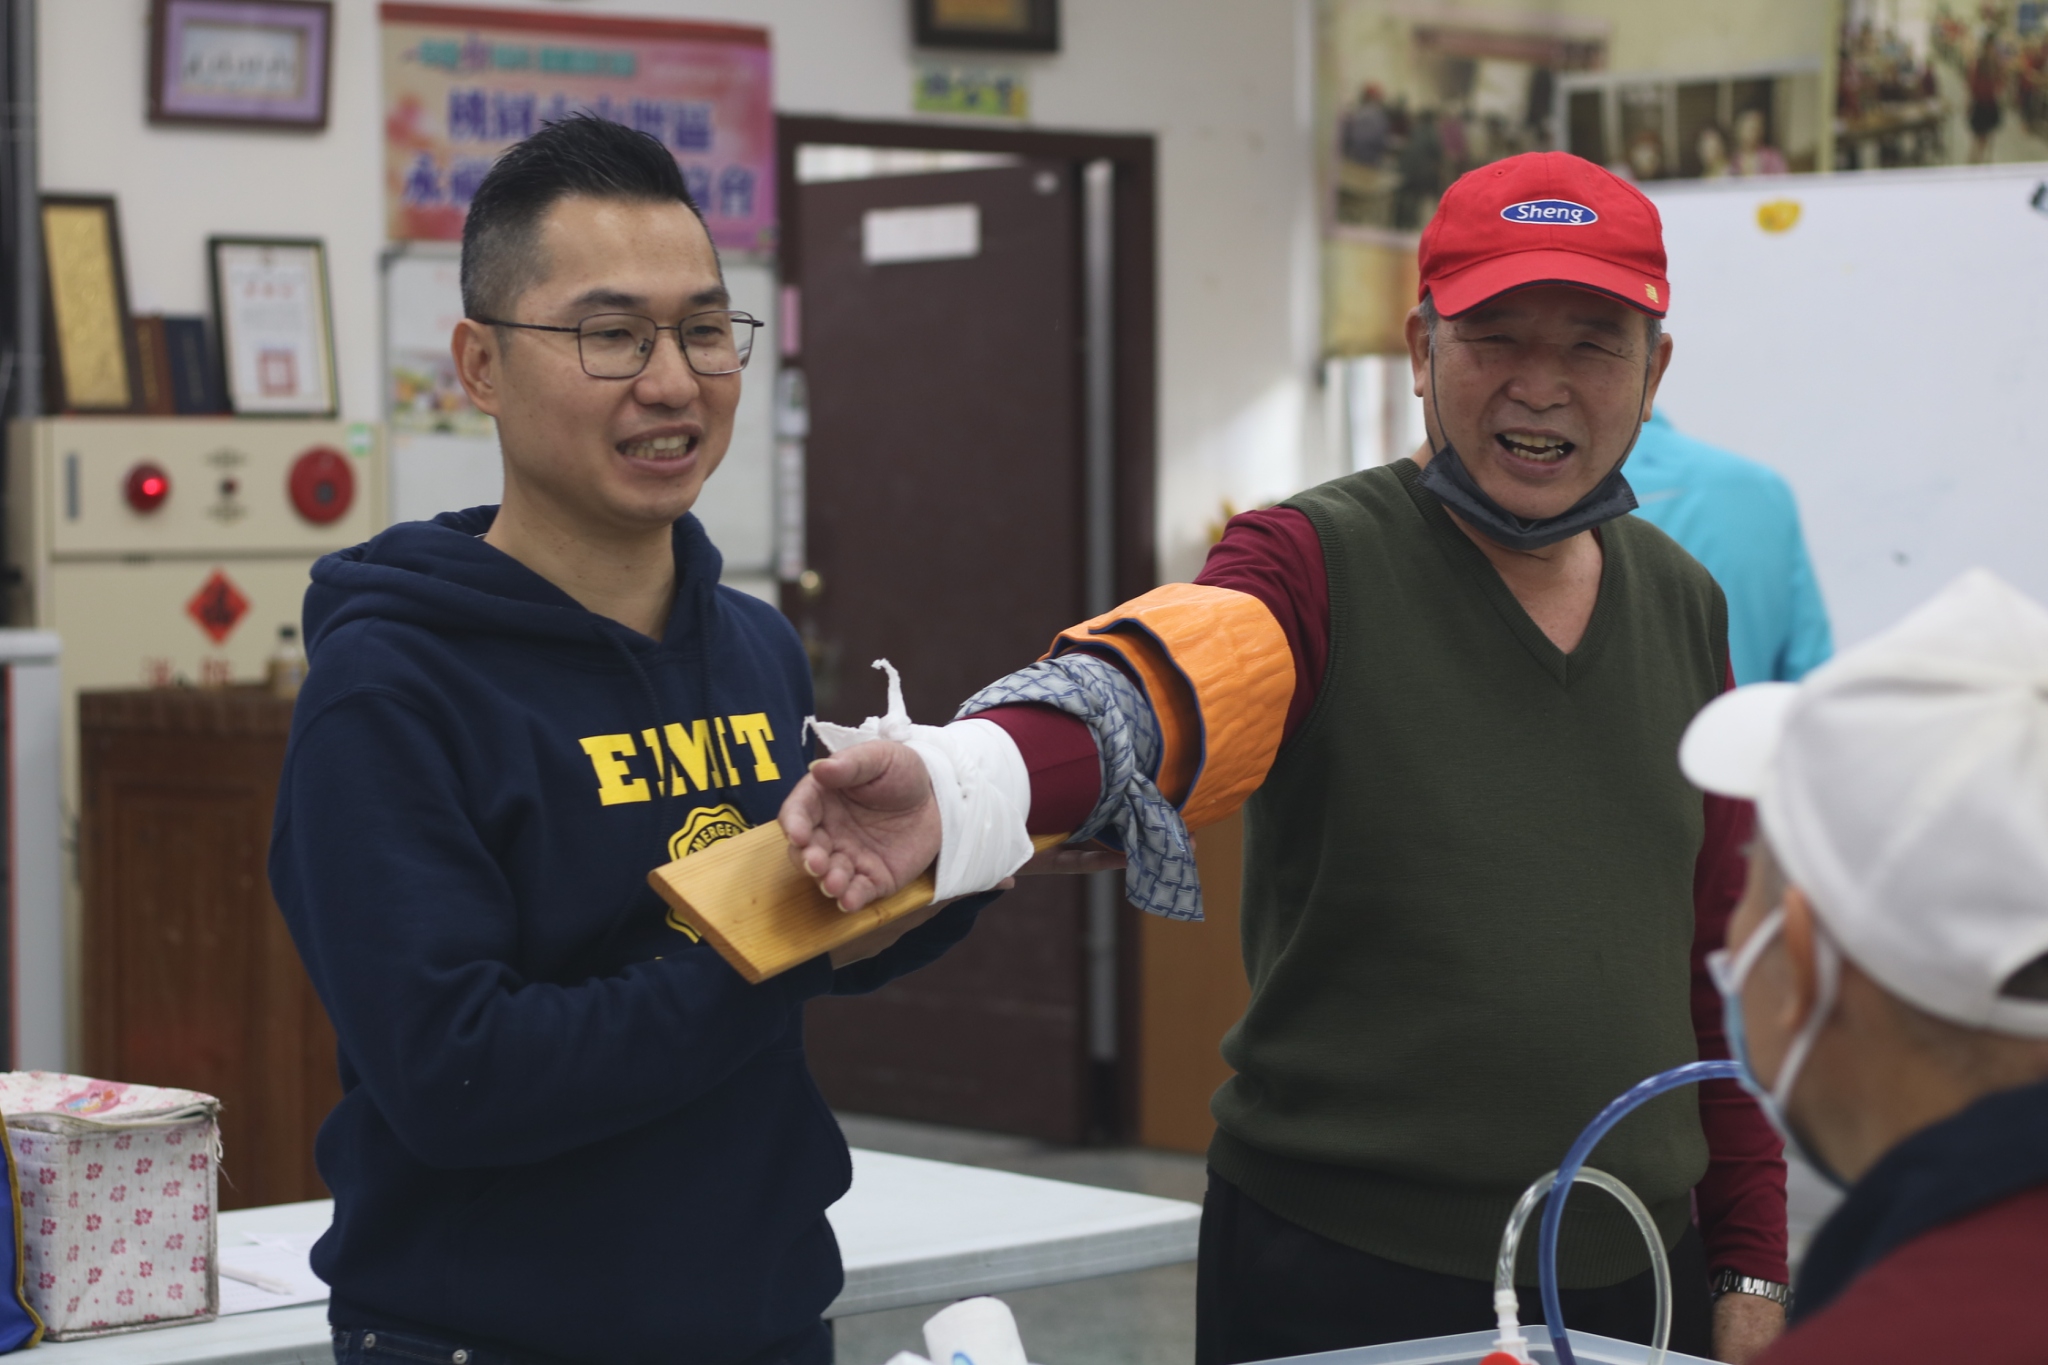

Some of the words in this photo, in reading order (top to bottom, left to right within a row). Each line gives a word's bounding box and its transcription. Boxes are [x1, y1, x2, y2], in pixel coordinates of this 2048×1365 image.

[1517, 205, 1584, 223] Sheng
[579, 713, 780, 806] EMT
[689, 823, 741, 855] MERGE
